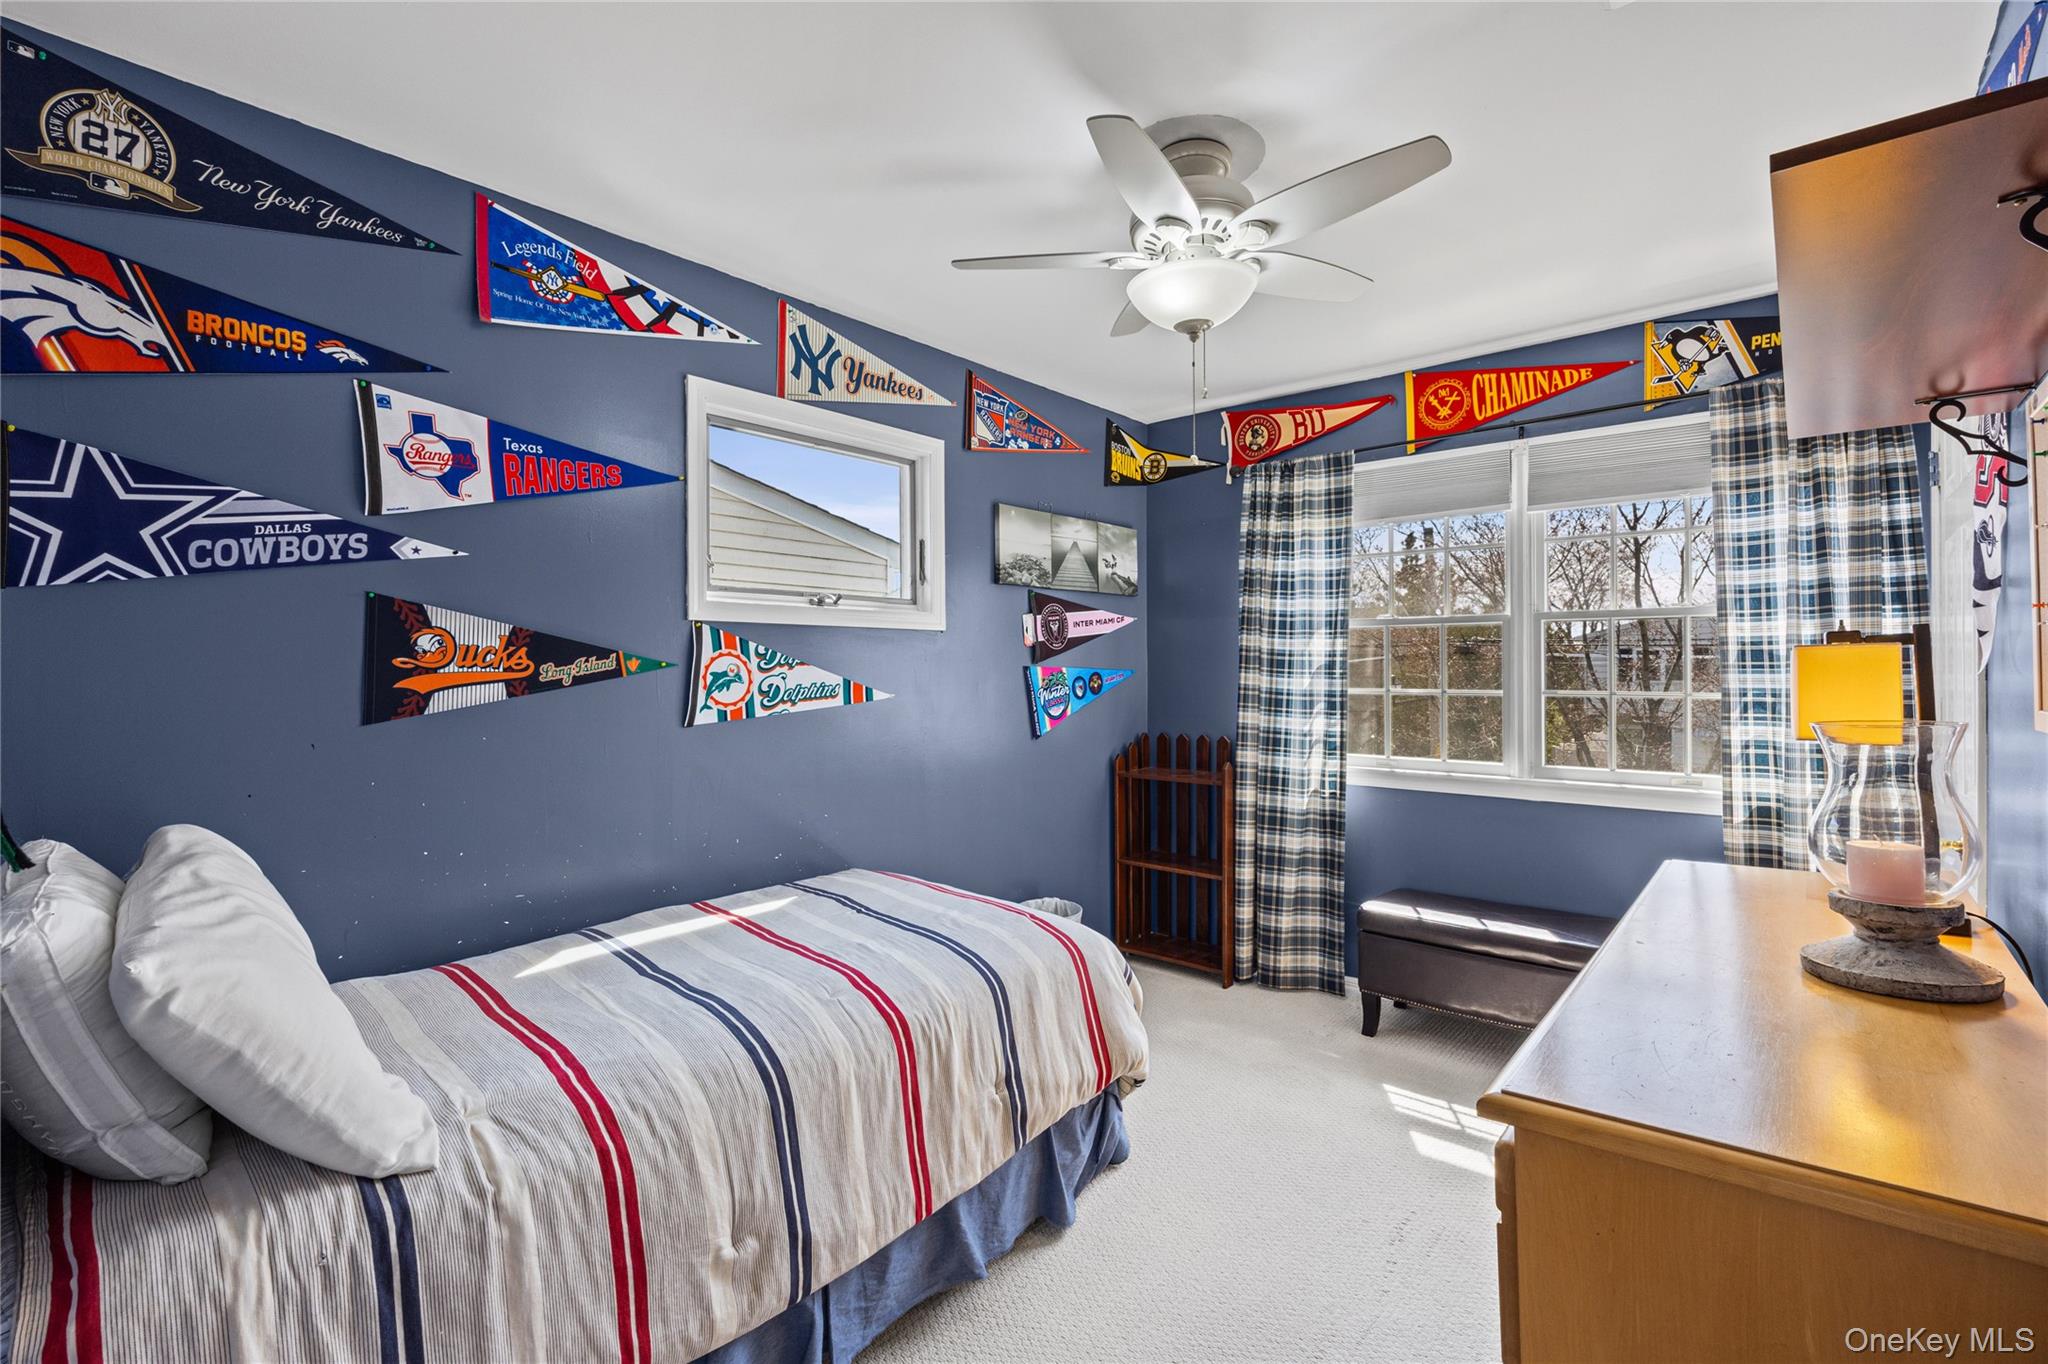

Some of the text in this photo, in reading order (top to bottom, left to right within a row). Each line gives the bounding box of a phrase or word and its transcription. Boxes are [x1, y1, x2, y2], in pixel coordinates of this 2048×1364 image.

[50, 96, 81, 138] NEW YORK
[81, 119, 140, 164] 27
[140, 121, 168, 171] YANKEES
[45, 150, 170, 195] WORLD CHAMPIONSHIPS
[192, 159, 402, 243] New York Yankees
[501, 241, 598, 282] Legends Field
[515, 295, 534, 306] Home
[187, 309, 307, 353] BRONCOS
[195, 334, 303, 361] FOOTBALL
[843, 356, 923, 401] Yankees
[1471, 368, 1593, 421] CHAMINADE
[990, 401, 1004, 413] YORK
[1031, 423, 1055, 441] YORK
[1287, 408, 1327, 446] BU
[405, 442, 474, 468] Rangers
[503, 437, 543, 454] Texas
[1111, 441, 1131, 456] BOSTON
[503, 452, 622, 497] RANGERS
[1111, 449, 1142, 481] BRUINS
[255, 523, 312, 535] DALLAS
[187, 533, 369, 569] COWBOYS
[1073, 619, 1094, 628] INTER
[1095, 617, 1115, 626] MIAMI
[392, 627, 534, 670] Ducks
[539, 652, 616, 685] Long Island
[758, 673, 841, 709] Dolphins
